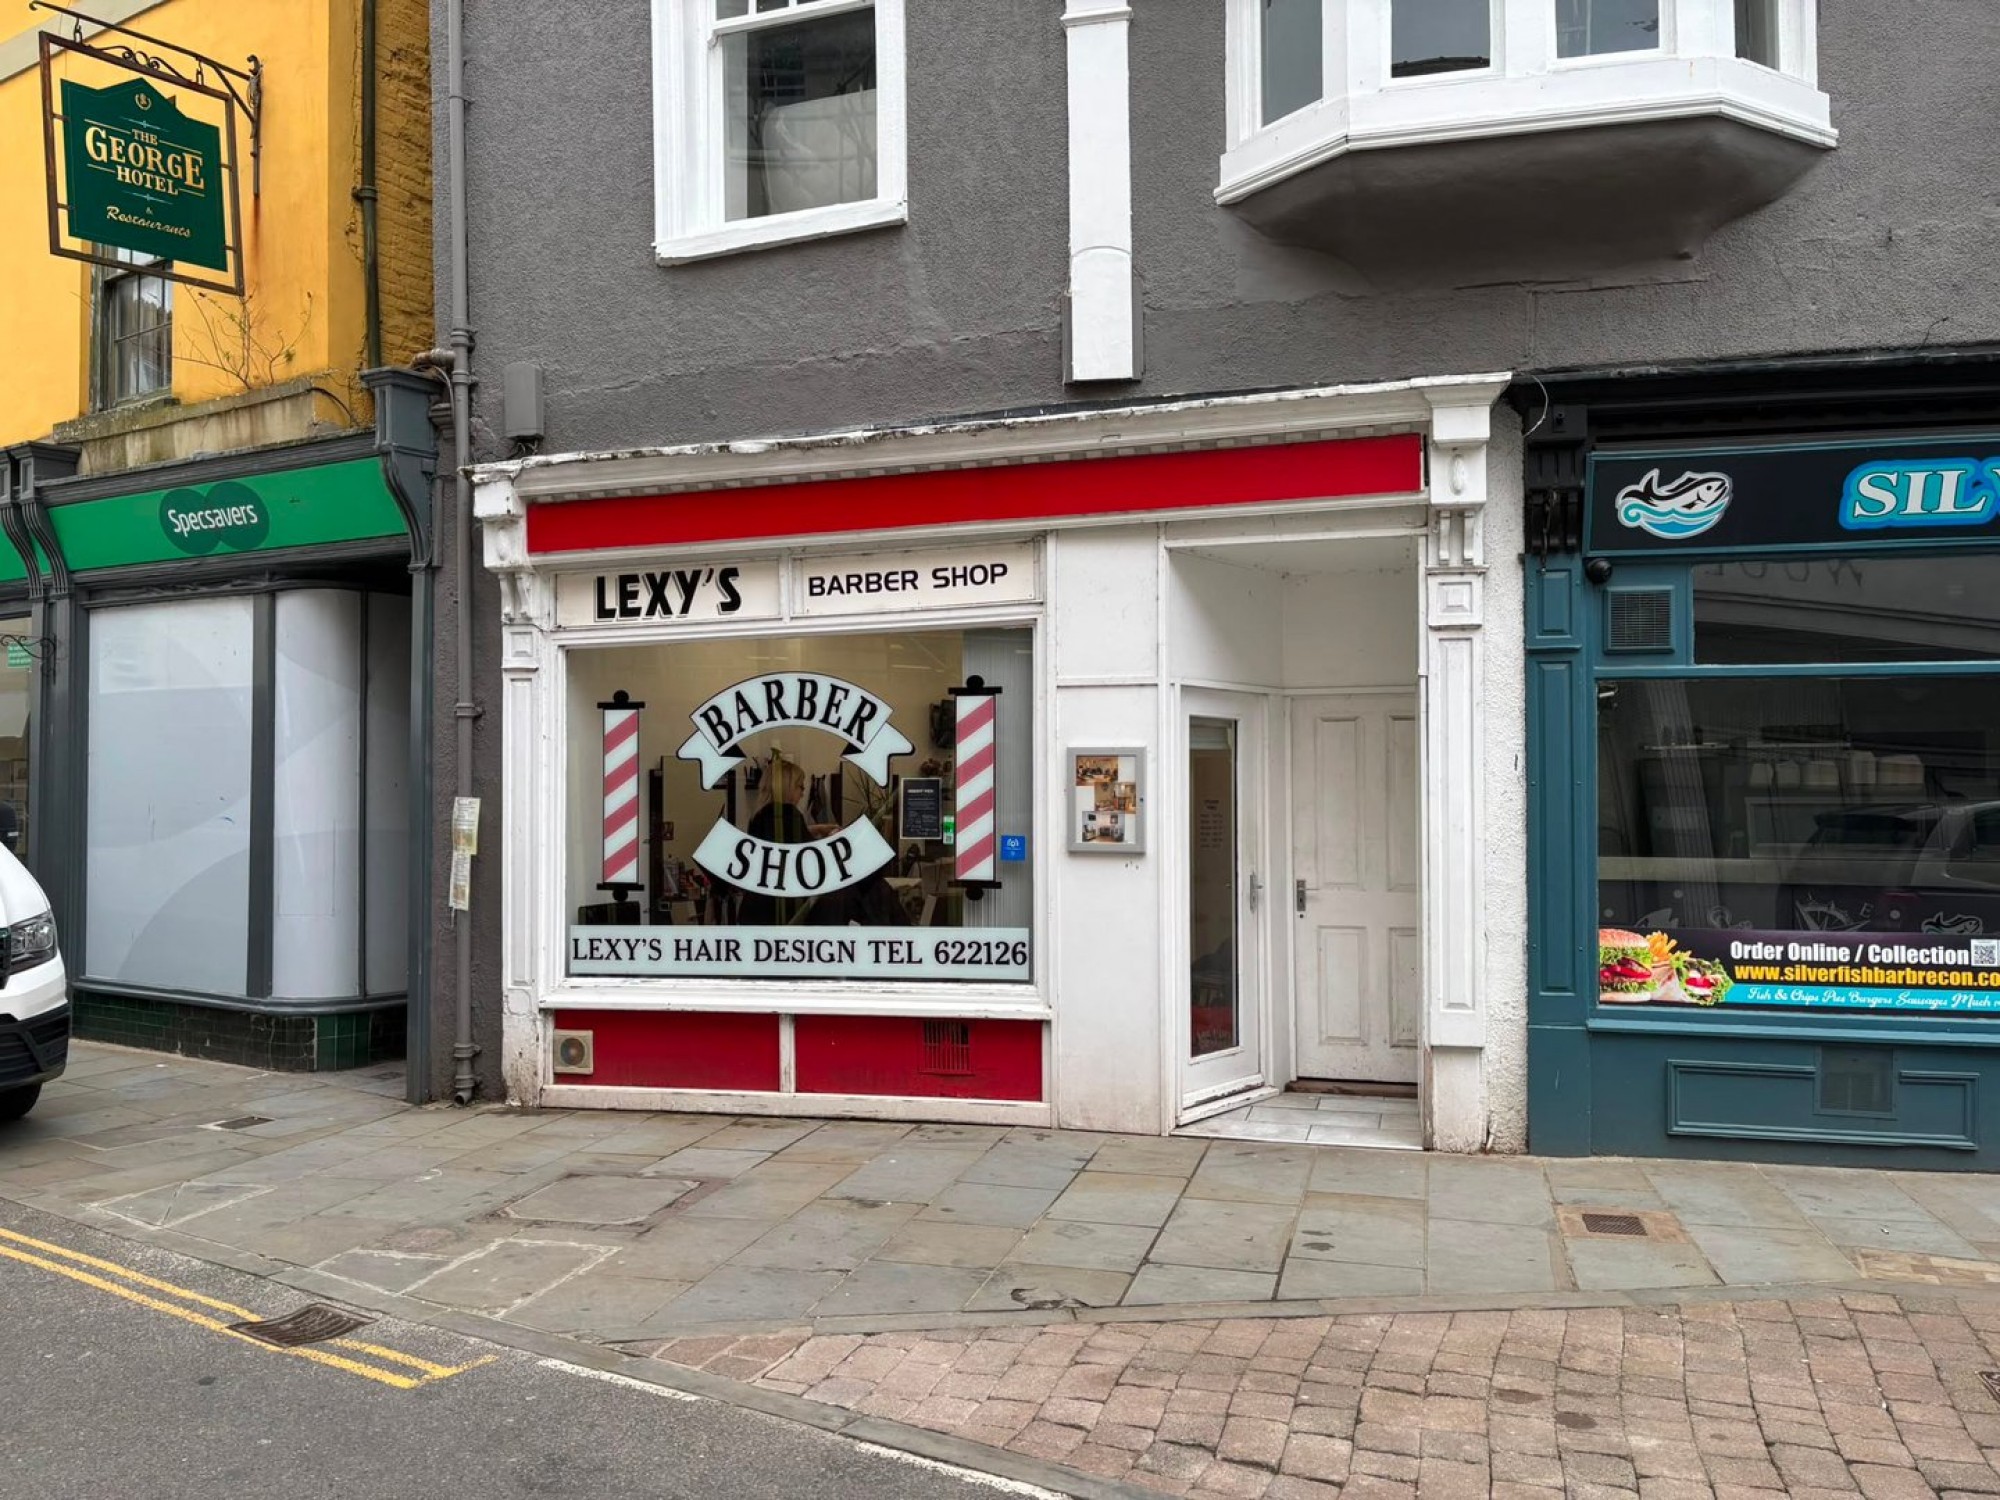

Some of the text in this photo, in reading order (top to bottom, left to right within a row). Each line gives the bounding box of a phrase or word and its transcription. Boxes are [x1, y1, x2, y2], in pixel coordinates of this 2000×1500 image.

[131, 129, 158, 145] THE
[85, 126, 205, 190] GEORGE
[116, 165, 179, 196] HOTEL
[1853, 470, 2000, 517] SIL
[168, 503, 258, 537] Specsavers
[593, 567, 742, 621] LEXY'S
[808, 563, 1008, 597] BARBER SHOP
[699, 677, 878, 749] BARBER
[727, 835, 853, 890] SHOP
[573, 938, 1028, 966] LEXY'S HAIR DESIGN TEL 622126
[1730, 940, 1784, 960] Order
[1788, 942, 1851, 962] Online
[1867, 943, 1970, 965] Collection
[1747, 987, 1771, 1001] Fish
[1774, 988, 1788, 1001] &
[1790, 989, 1819, 1006] Chips
[1848, 991, 1892, 1008] Burgers
[1896, 991, 1948, 1010] Sausages
[1951, 993, 1991, 1008] Much
